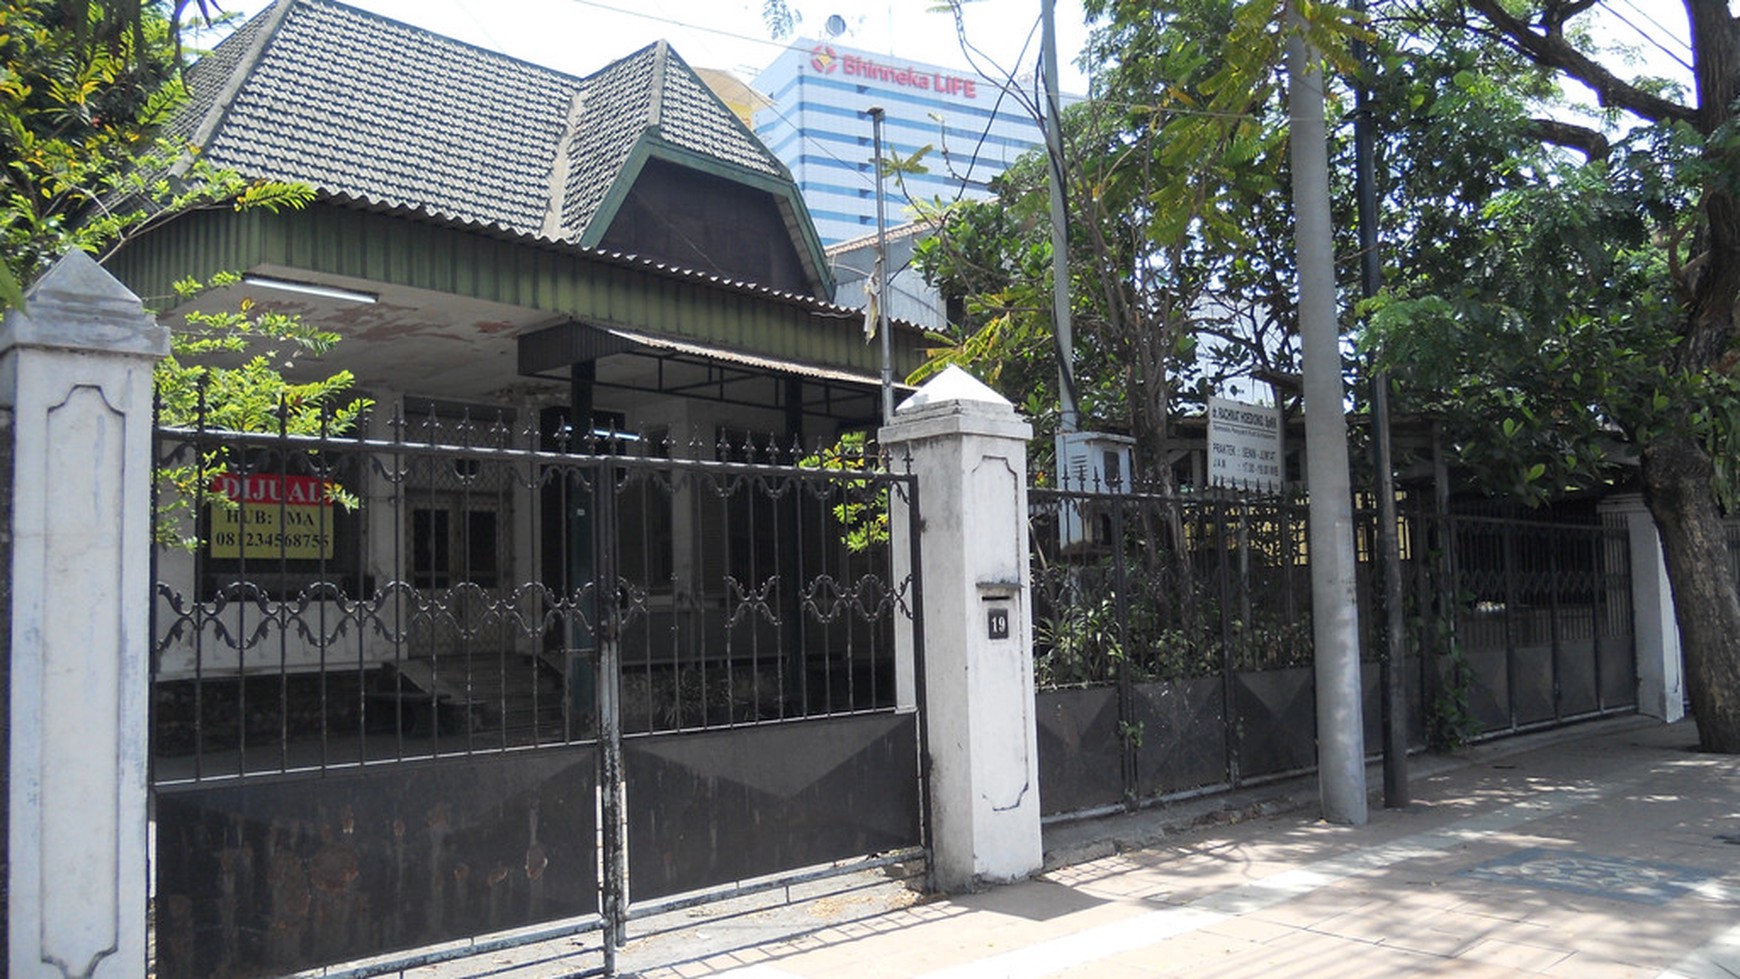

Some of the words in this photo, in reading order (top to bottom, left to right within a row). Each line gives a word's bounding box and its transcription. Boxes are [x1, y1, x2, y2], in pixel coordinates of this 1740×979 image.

[843, 53, 930, 89] Bhinneka
[934, 72, 977, 99] LIFE
[221, 477, 322, 502] DIJUAL
[992, 616, 1006, 633] 19
